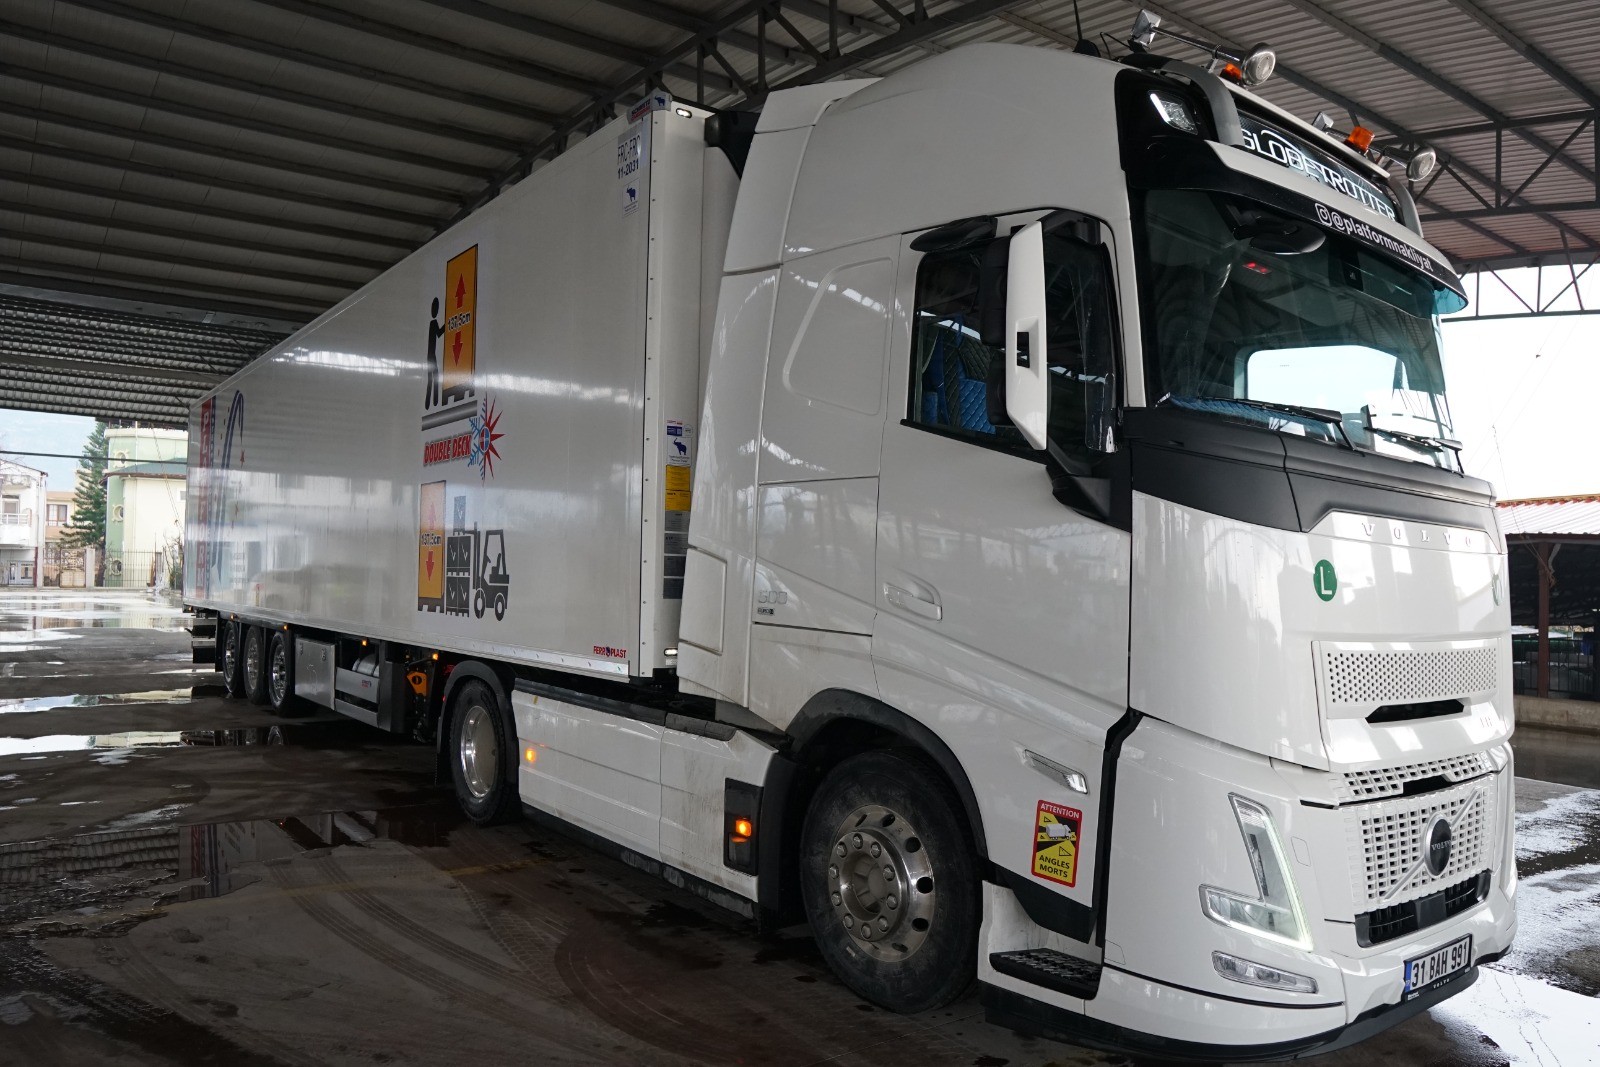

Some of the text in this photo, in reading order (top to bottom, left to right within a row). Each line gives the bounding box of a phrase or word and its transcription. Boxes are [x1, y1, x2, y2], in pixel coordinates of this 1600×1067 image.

[617, 158, 640, 179] 11-2031
[1241, 128, 1396, 221] GLOBETROTTER
[1331, 212, 1434, 272] @platformnakliyat
[424, 434, 471, 464] DOUBLE DECK
[197, 411, 209, 588] PLAFORM
[1361, 522, 1471, 547] VOLVO
[1319, 566, 1333, 595] L
[1040, 803, 1080, 819] ATTENTION
[1039, 854, 1070, 870] ANGLES
[1039, 864, 1068, 878] MORTS
[1411, 941, 1468, 988] 31 BAH 991
